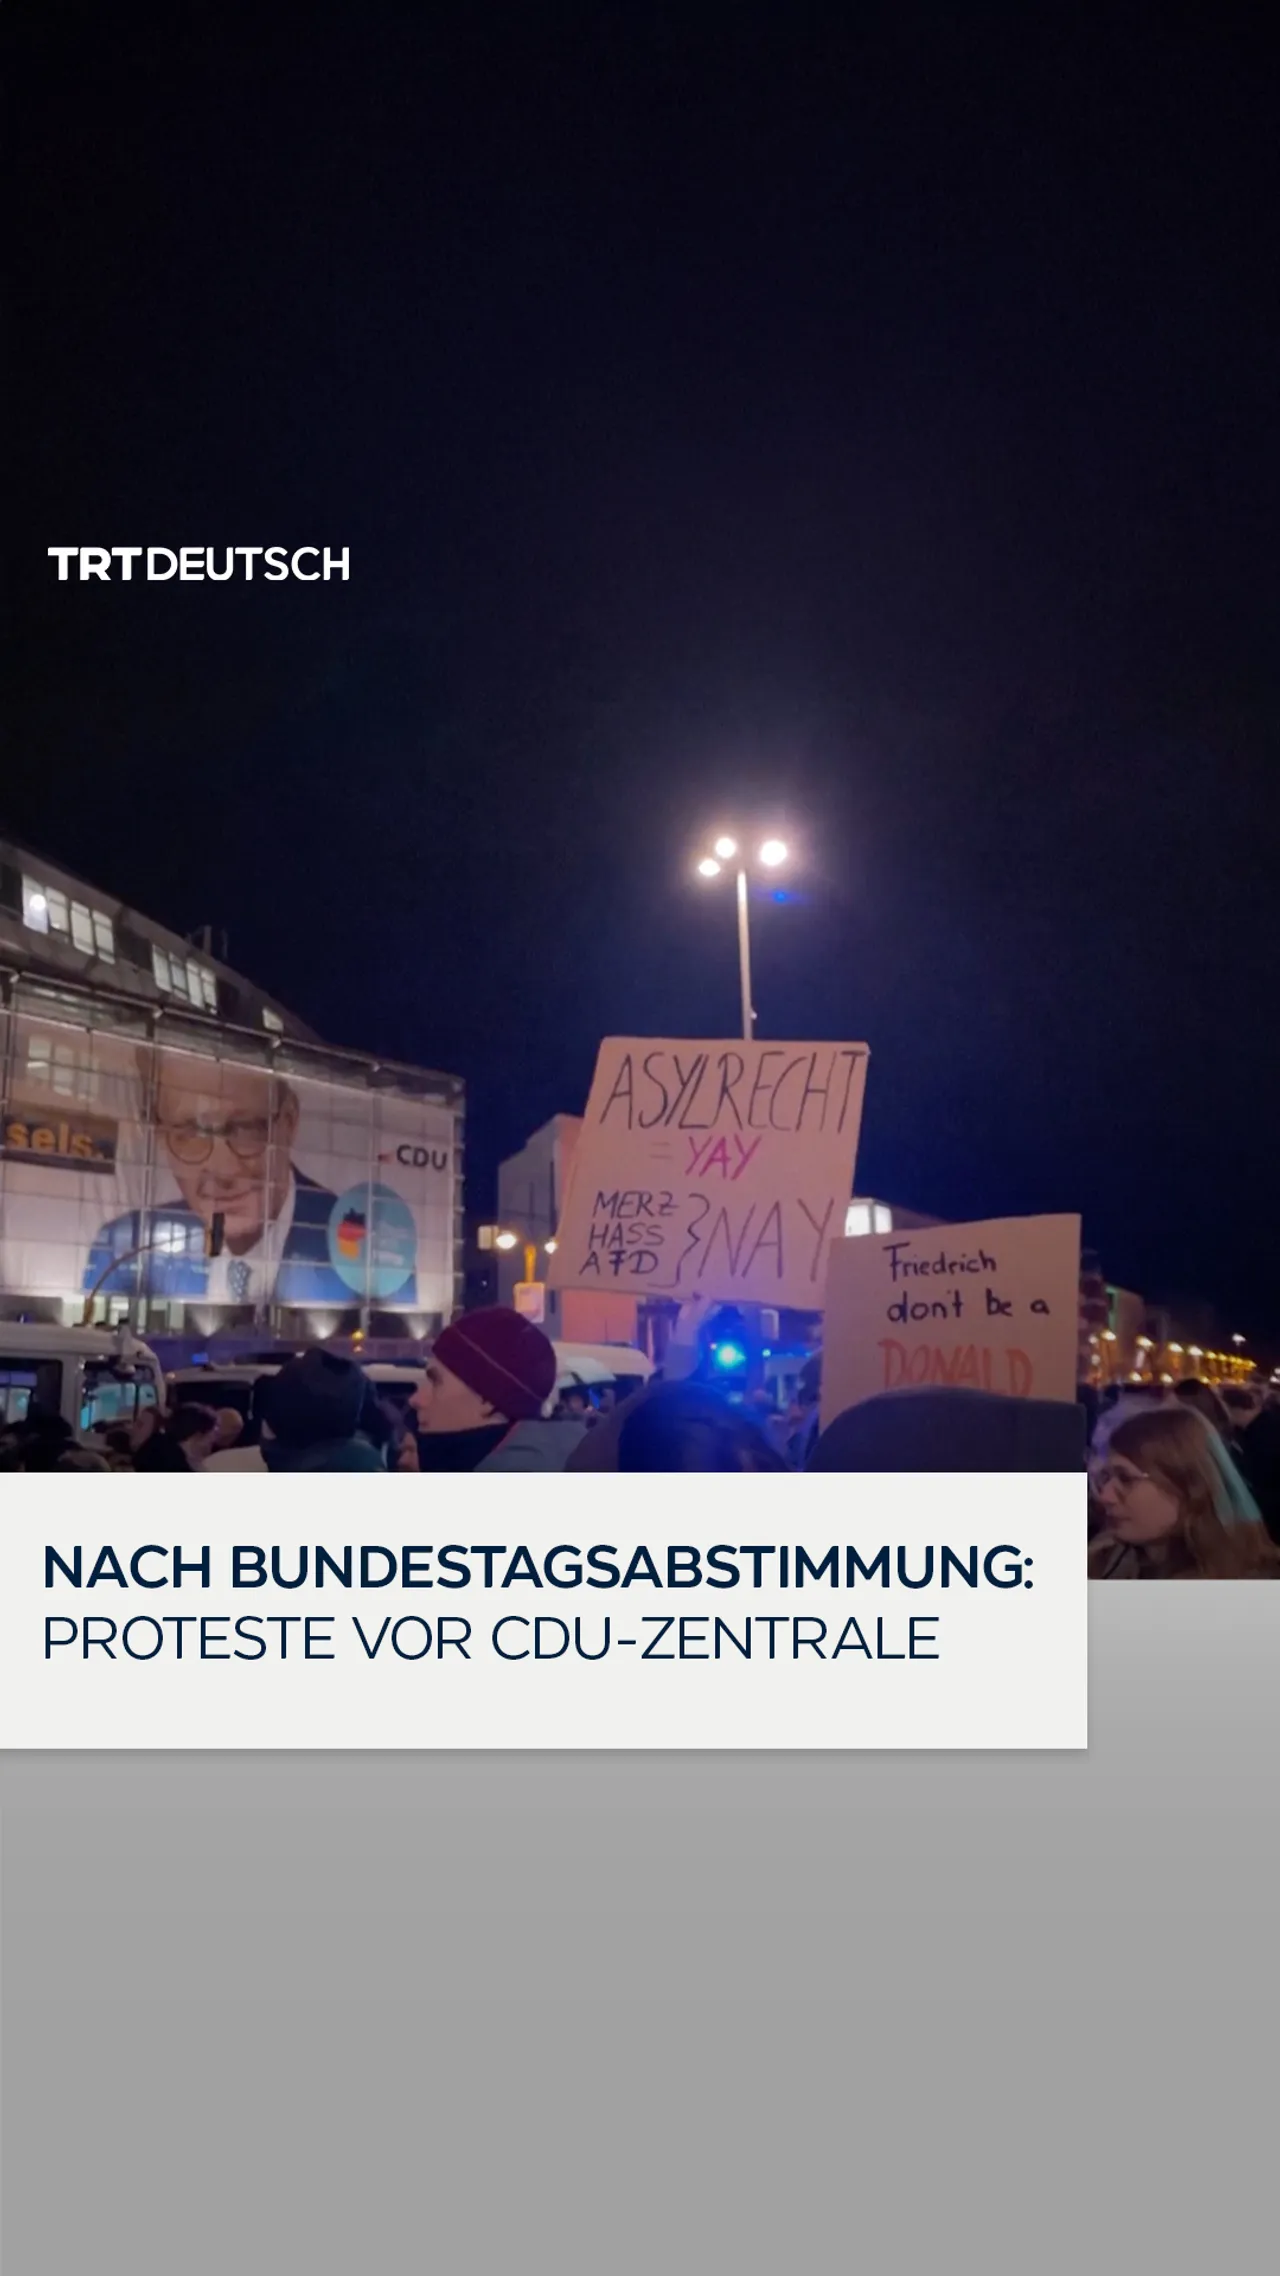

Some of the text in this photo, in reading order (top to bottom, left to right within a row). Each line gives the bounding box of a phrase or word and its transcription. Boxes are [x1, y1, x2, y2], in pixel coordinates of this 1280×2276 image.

[600, 1050, 867, 1133] ASYLRECHT
[396, 1144, 448, 1171] CDU
[685, 1133, 762, 1181] YAY
[592, 1189, 679, 1220] MERZ
[588, 1222, 665, 1250] HASS
[697, 1197, 836, 1282] NAY
[882, 1241, 998, 1282] Friedrich
[887, 1287, 1051, 1324] don't be a
[877, 1337, 1035, 1397] DONALD
